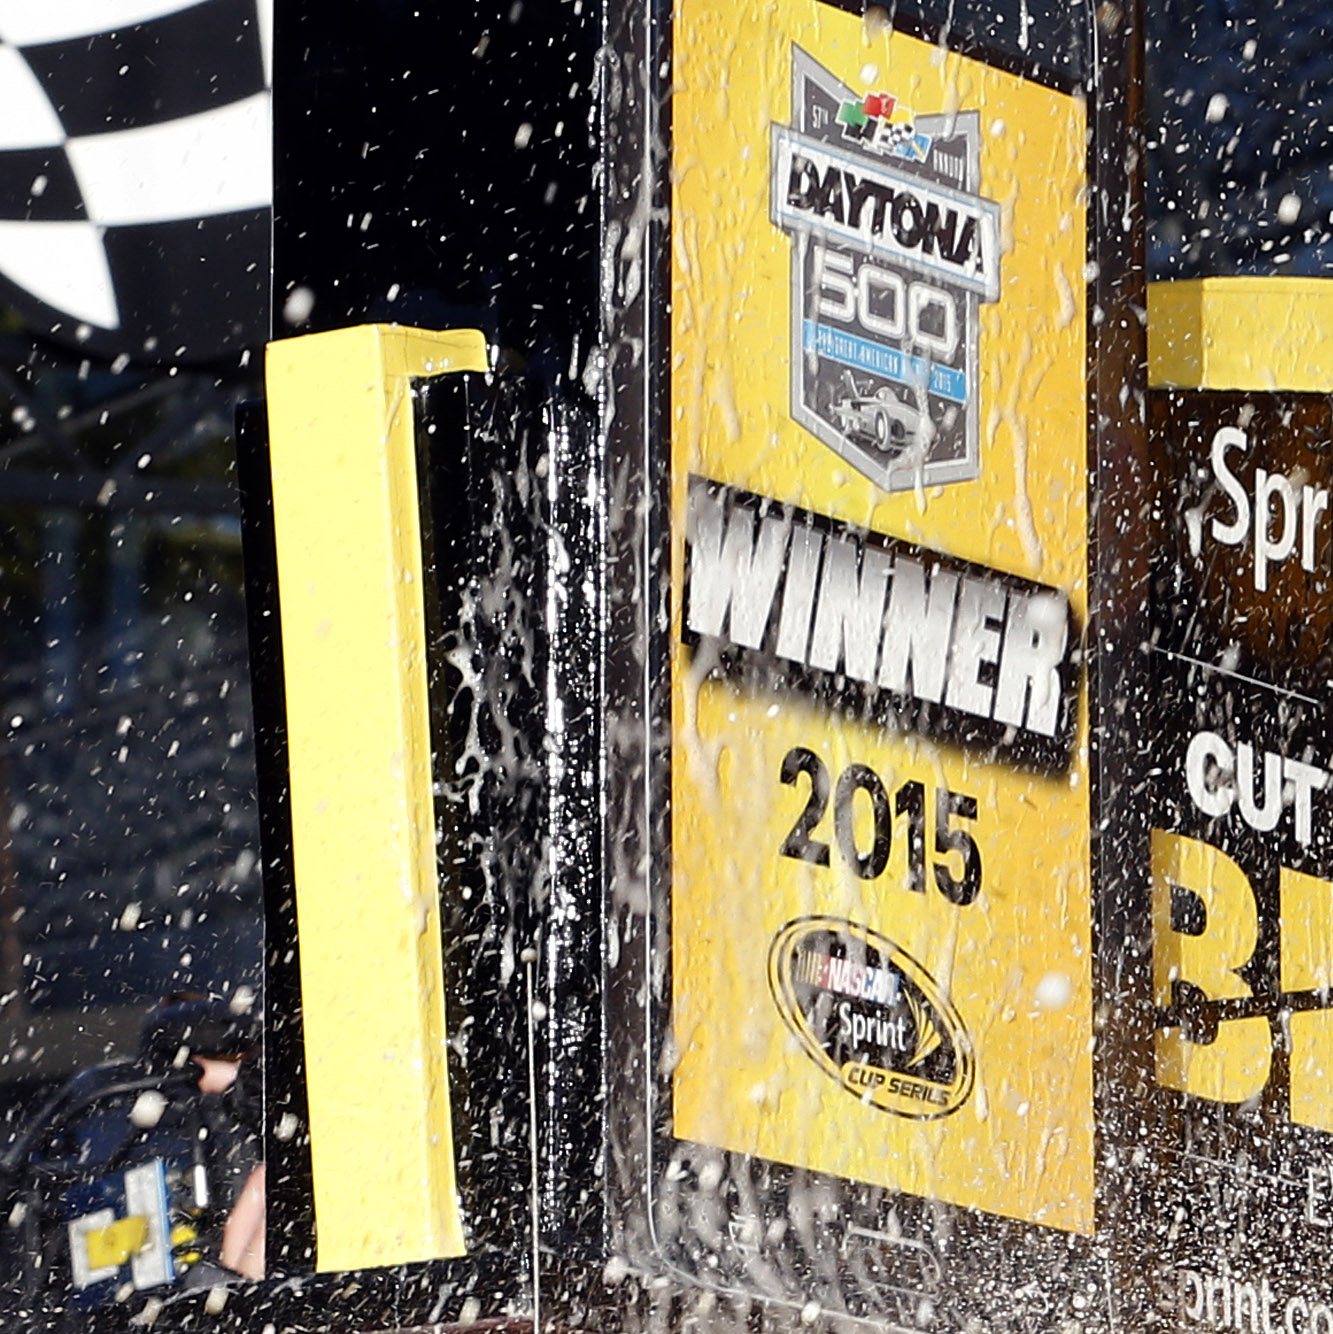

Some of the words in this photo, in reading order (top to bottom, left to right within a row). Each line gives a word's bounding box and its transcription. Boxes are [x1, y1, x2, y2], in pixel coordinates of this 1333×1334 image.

[786, 154, 985, 275] DAYTONA
[814, 246, 959, 358] 500
[687, 494, 1069, 738] WINNER
[779, 746, 983, 906] 2015
[1186, 731, 1330, 848] CUT
[839, 1002, 907, 1052] Sprint
[848, 1067, 886, 1091] CUP
